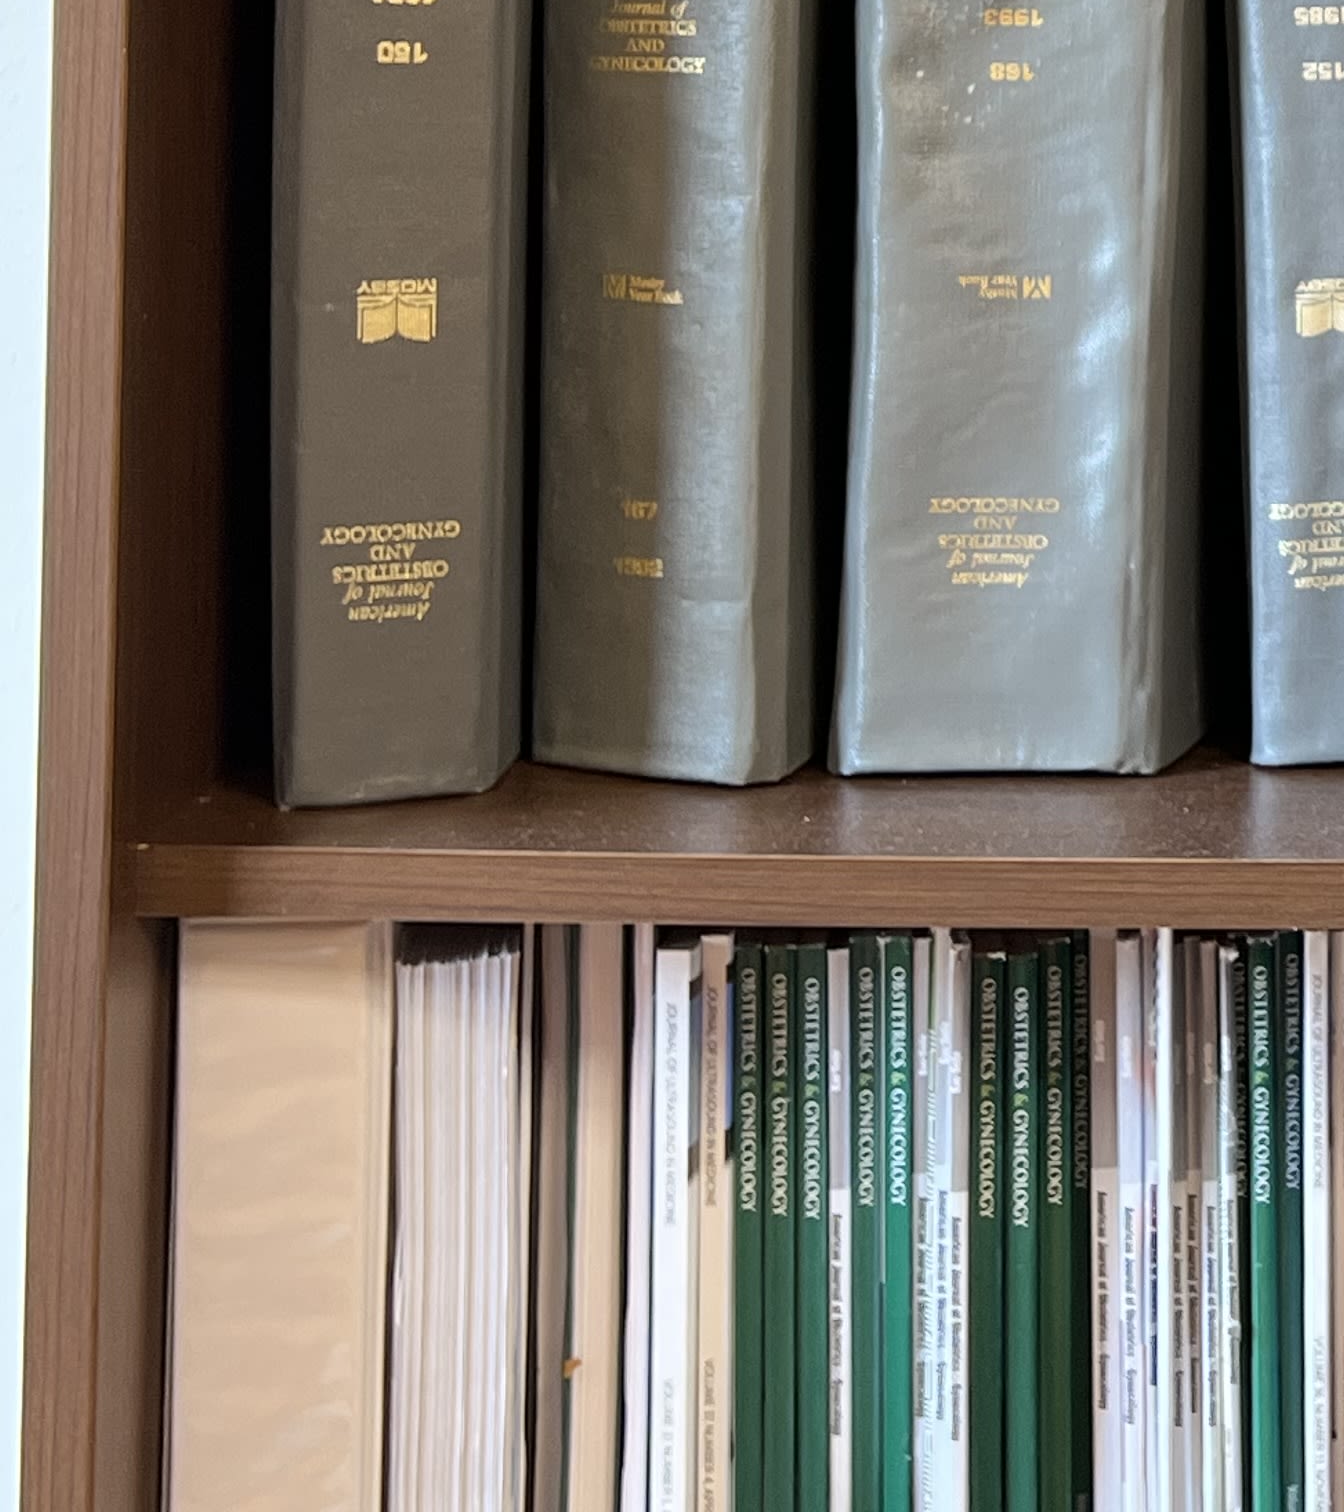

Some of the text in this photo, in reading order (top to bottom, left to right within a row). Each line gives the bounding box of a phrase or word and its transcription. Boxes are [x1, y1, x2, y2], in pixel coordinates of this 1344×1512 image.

[624, 38, 666, 52] AND
[670, 0, 689, 19] of
[983, 8, 1044, 28] 1993
[989, 62, 1034, 82] 168
[356, 278, 438, 296] MOSBY
[319, 519, 461, 546] GYNECOLOGY
[370, 543, 416, 561] AND
[928, 497, 1060, 513] GYNECOLOGY
[937, 533, 1049, 550] OBSTETRICS
[973, 515, 1017, 531] AND
[331, 558, 450, 584] OBSTETRICS
[342, 581, 435, 605] Journal of
[945, 549, 1035, 569] Journal of
[951, 571, 1029, 589] American
[1287, 554, 1308, 575] of
[347, 600, 431, 623] American
[740, 967, 757, 1071] OBSTETRICS
[771, 972, 788, 1077] OBSTETRICS
[803, 977, 820, 1080] OBSTETRICS
[857, 966, 874, 1069] OBSTETRICS
[890, 965, 907, 1068] OBSTETRICS
[979, 977, 997, 1080] OBSTETRICS
[1013, 985, 1030, 1090] OBSTETRICS
[1047, 965, 1063, 1068] OBSTETRICS
[1254, 964, 1270, 1068] OBSTETRICS
[1286, 953, 1300, 1055] OBSTETRICS
[740, 1092, 757, 1213] GYNECOLOGY
[771, 1098, 788, 1217] GYNECOLOGY
[803, 1099, 820, 1221] GYNECOLOGY
[857, 1088, 874, 1207] GYNECOLOGY
[890, 1087, 907, 1207] GYNECOLOGY
[979, 1099, 997, 1219] GYNECOLOGY
[1013, 1108, 1030, 1228] GYNECOLOGY
[1047, 1087, 1063, 1206] GYNECOLOGY
[1254, 1086, 1270, 1204] GYNECOLOGY
[1286, 1074, 1300, 1190] GYNECOLOGY
